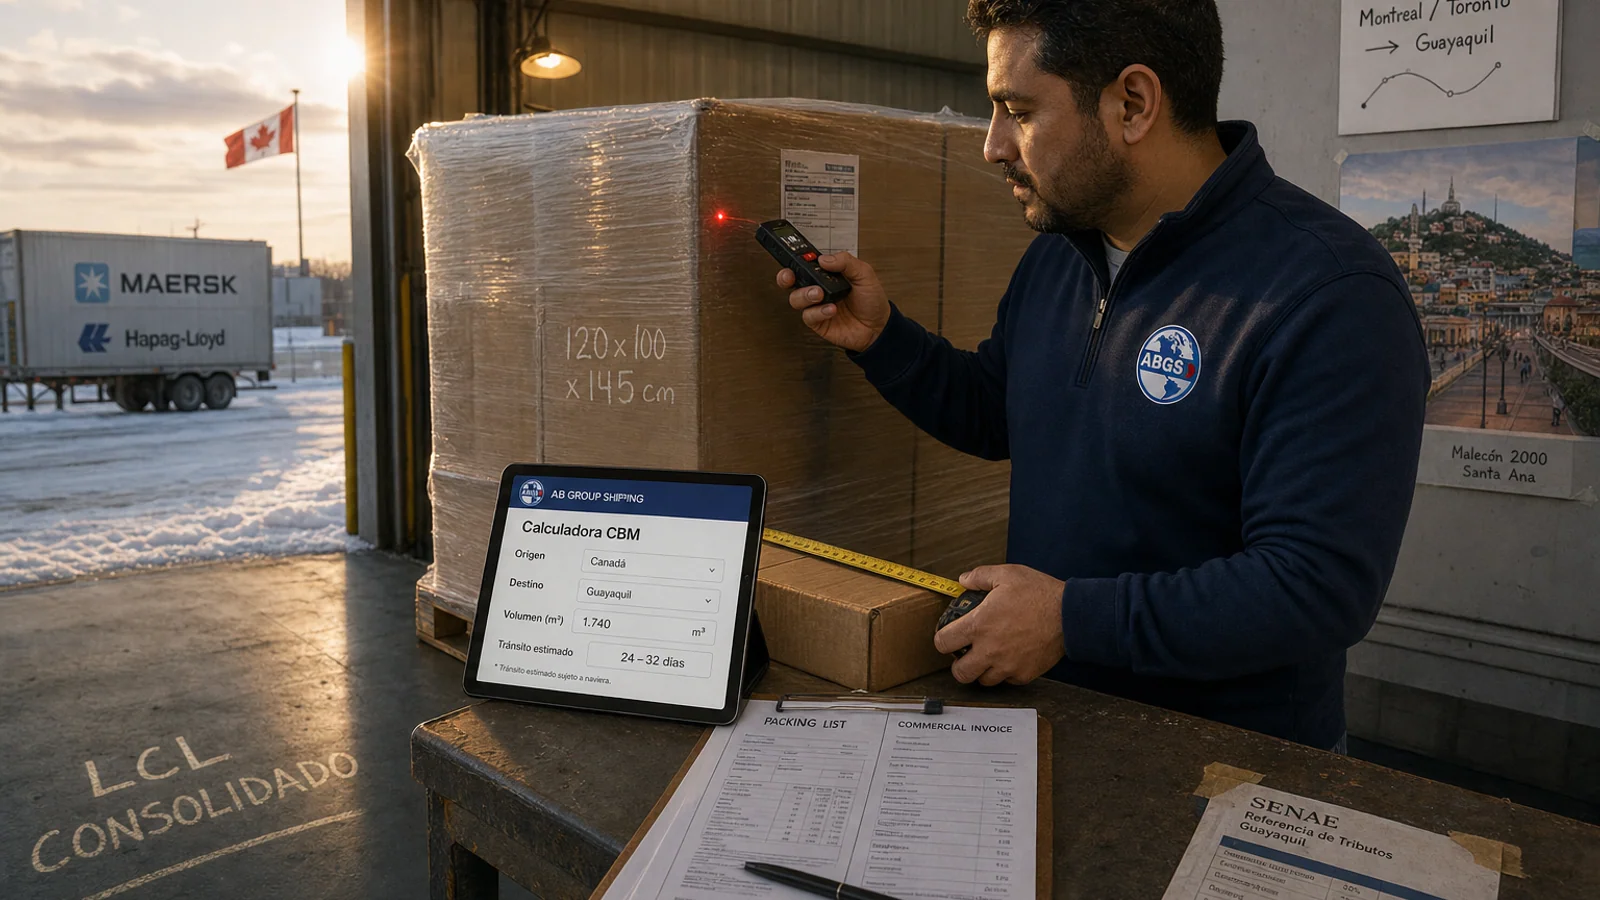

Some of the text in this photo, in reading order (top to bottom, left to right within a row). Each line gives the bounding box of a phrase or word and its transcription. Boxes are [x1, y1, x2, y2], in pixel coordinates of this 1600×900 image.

[1360, 0, 1511, 27] Montreal / Toronto
[1415, 24, 1494, 55] Guayaquil
[120, 273, 238, 294] MAERSK
[566, 323, 667, 360] 120 x 100
[1140, 352, 1184, 375] ABGS
[565, 369, 675, 405] x 145 cm
[1451, 445, 1548, 466] Malecón 2000
[1462, 465, 1537, 483] Santa Ana
[550, 489, 565, 499] AB
[567, 490, 601, 501] GROUP
[521, 520, 641, 541] Calculadora CBM
[514, 549, 546, 561] Origen
[590, 556, 626, 569] Canadá
[509, 577, 544, 590] Destino
[586, 586, 632, 601] Guayaquil
[503, 609, 543, 623] Volumen
[582, 616, 611, 629] 1.740
[497, 639, 574, 658] Tránsito estimado
[620, 651, 635, 664] 24
[645, 654, 660, 666] 32
[499, 664, 526, 675] Tránsito
[526, 669, 557, 679] estimado
[557, 672, 578, 682] sujeto
[763, 717, 847, 730] PACKING LIST
[897, 720, 1013, 733] COMMERCIAL INVOICE
[84, 735, 233, 798] LCL
[30, 751, 359, 873] CONSOLIDADO
[1249, 796, 1340, 830] SENAE
[1239, 821, 1307, 848] Guayaquil
[1243, 811, 1394, 860] Referencia de Tributos
